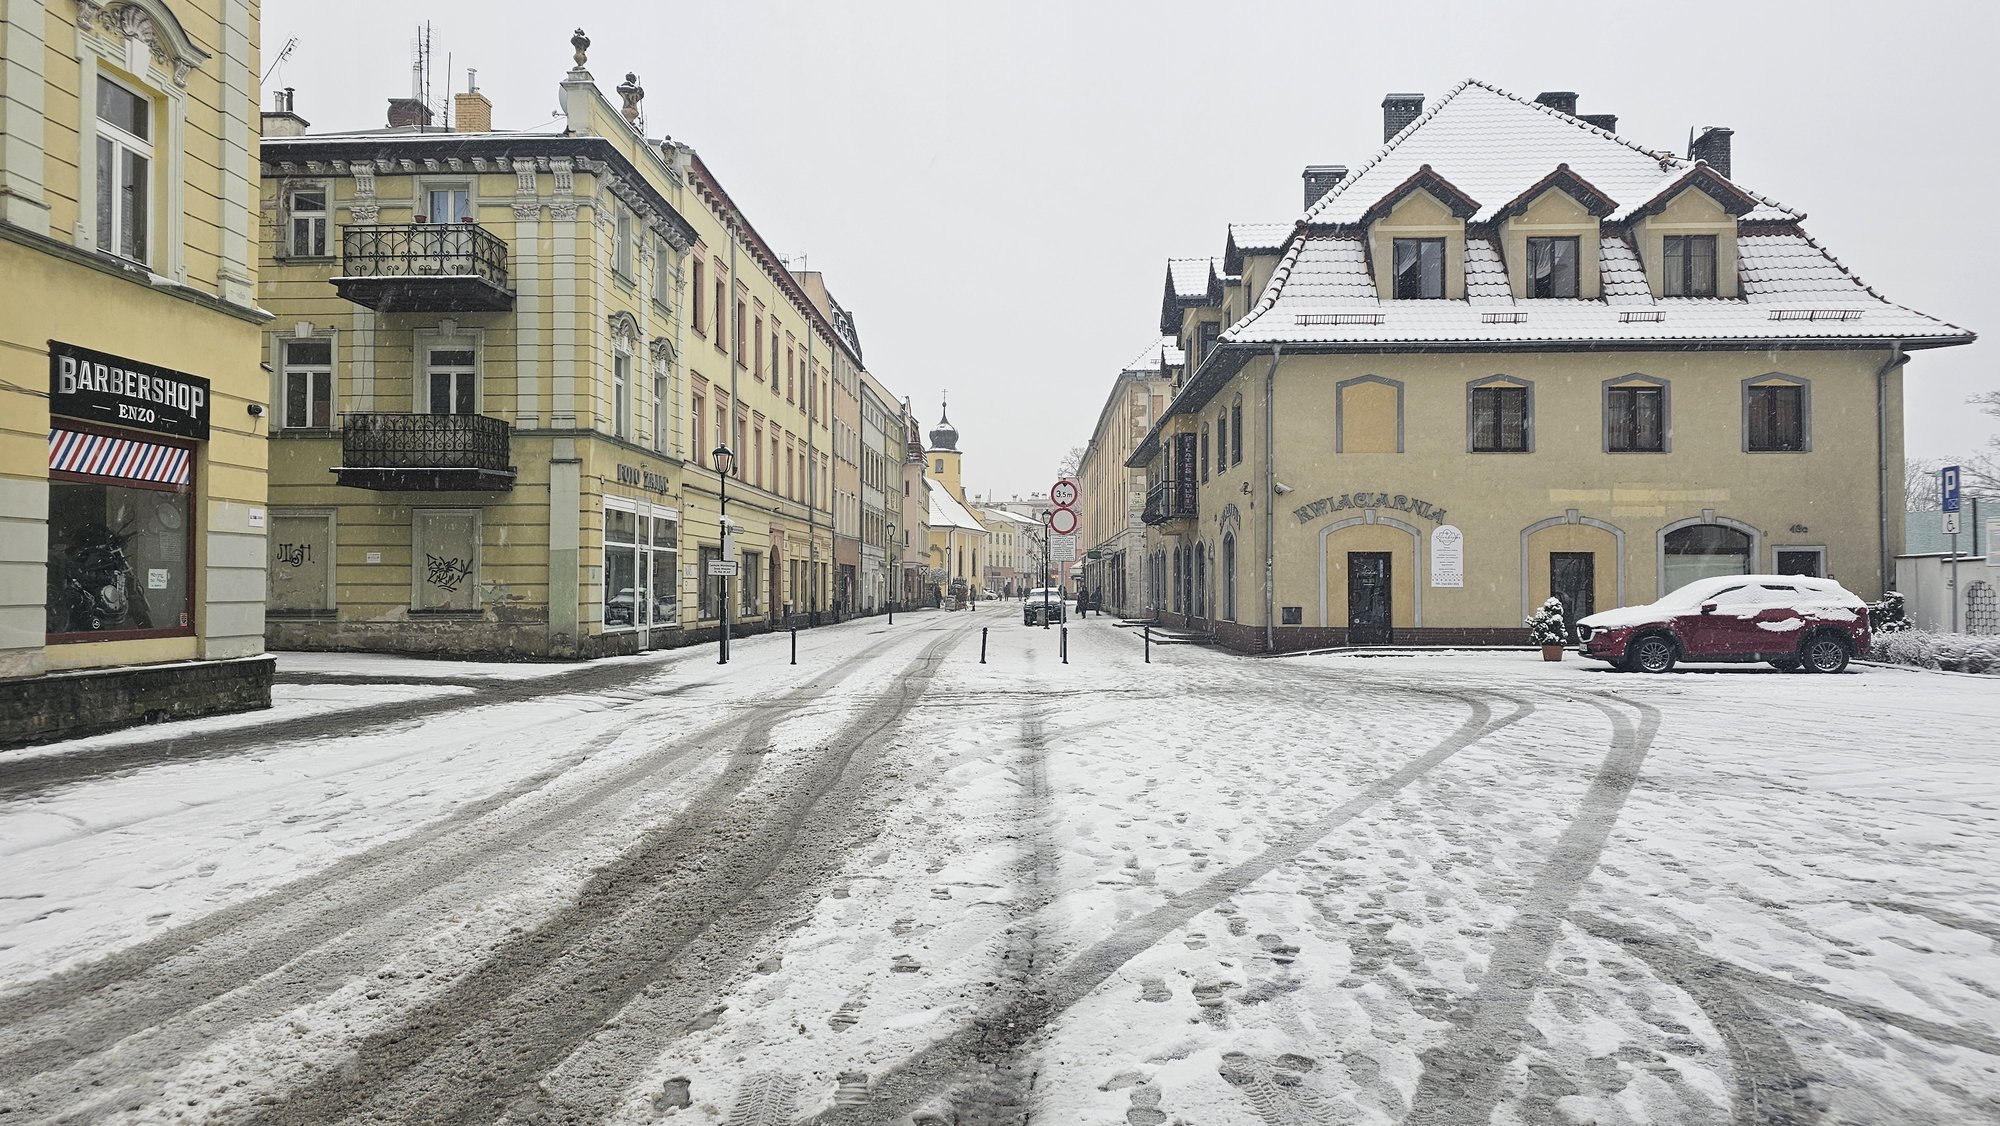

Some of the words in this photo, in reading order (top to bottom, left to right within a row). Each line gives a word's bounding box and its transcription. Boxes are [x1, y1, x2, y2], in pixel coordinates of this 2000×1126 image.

[58, 354, 204, 419] BARBERSHOP
[118, 403, 156, 424] ENZO
[617, 463, 640, 485] FOTO
[1945, 470, 1956, 499] P
[1292, 491, 1447, 526] KWIACIARNIA
